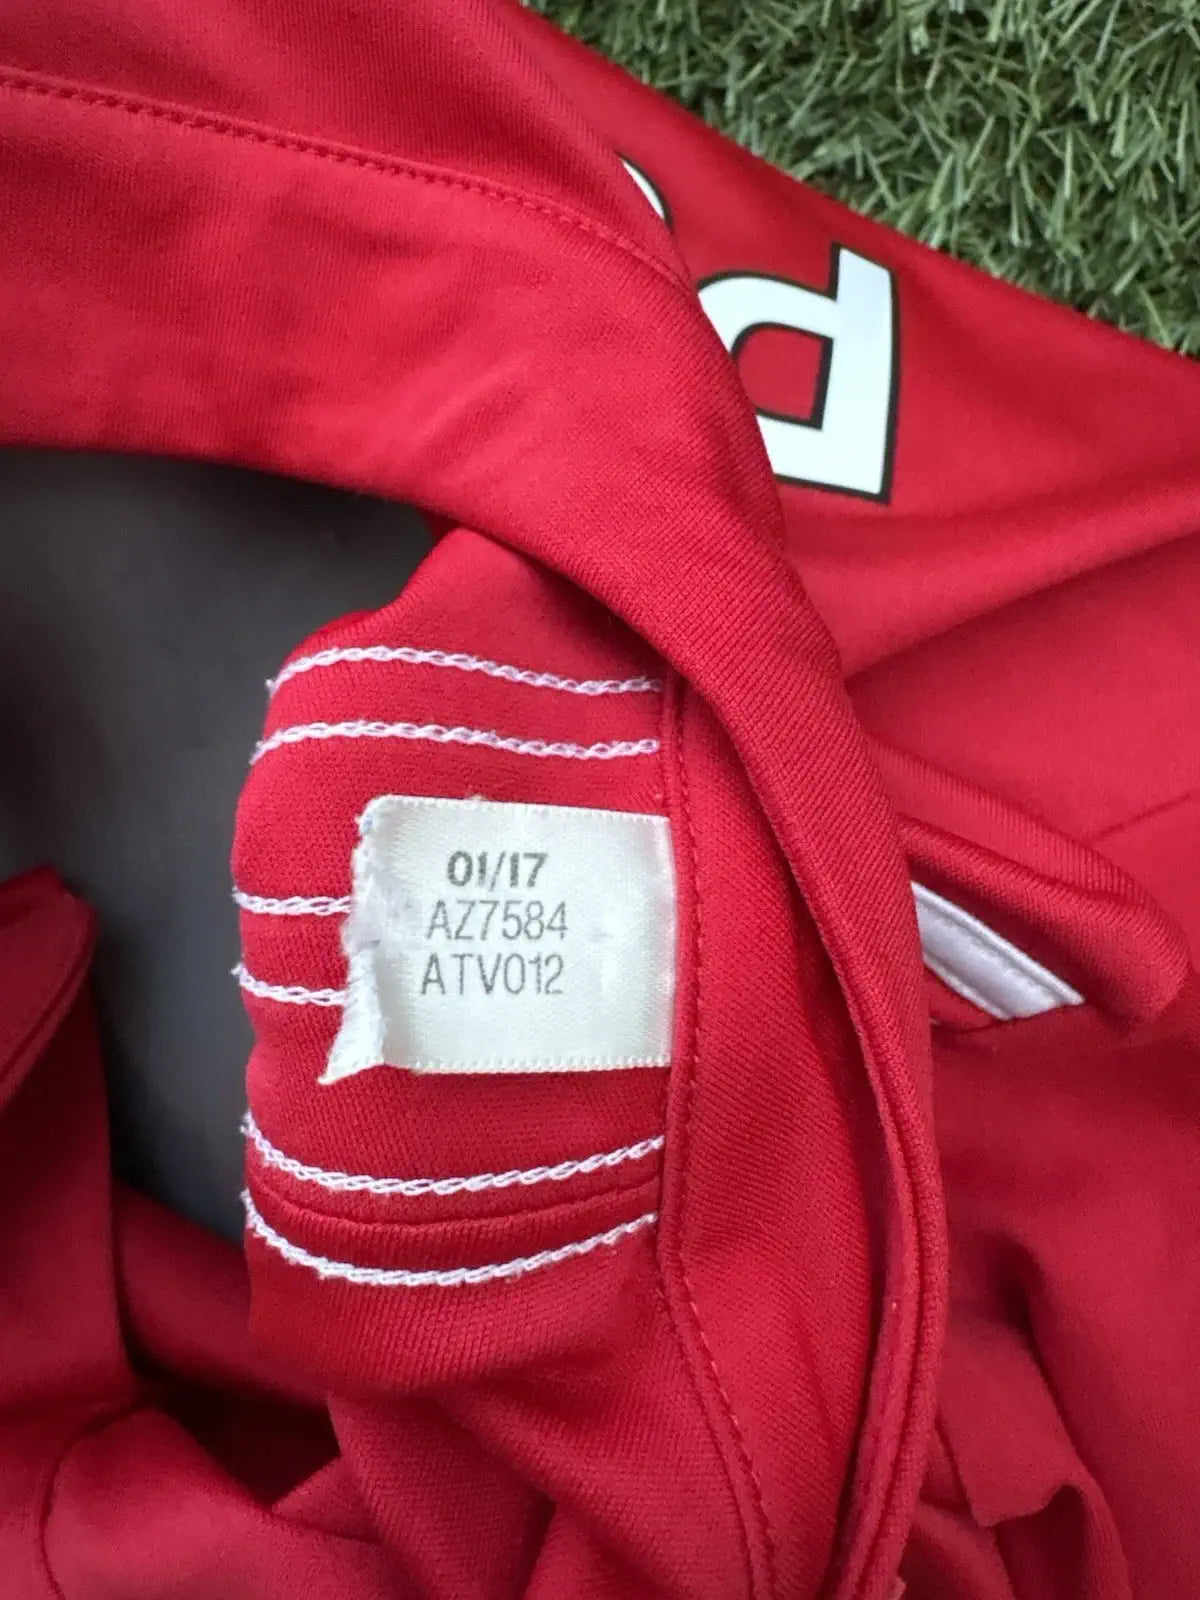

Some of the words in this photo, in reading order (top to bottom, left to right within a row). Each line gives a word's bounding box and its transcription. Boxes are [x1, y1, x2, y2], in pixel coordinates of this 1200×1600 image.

[447, 850, 549, 891] 01/17
[426, 899, 569, 940] AZ7584
[420, 953, 565, 995] ATV012
